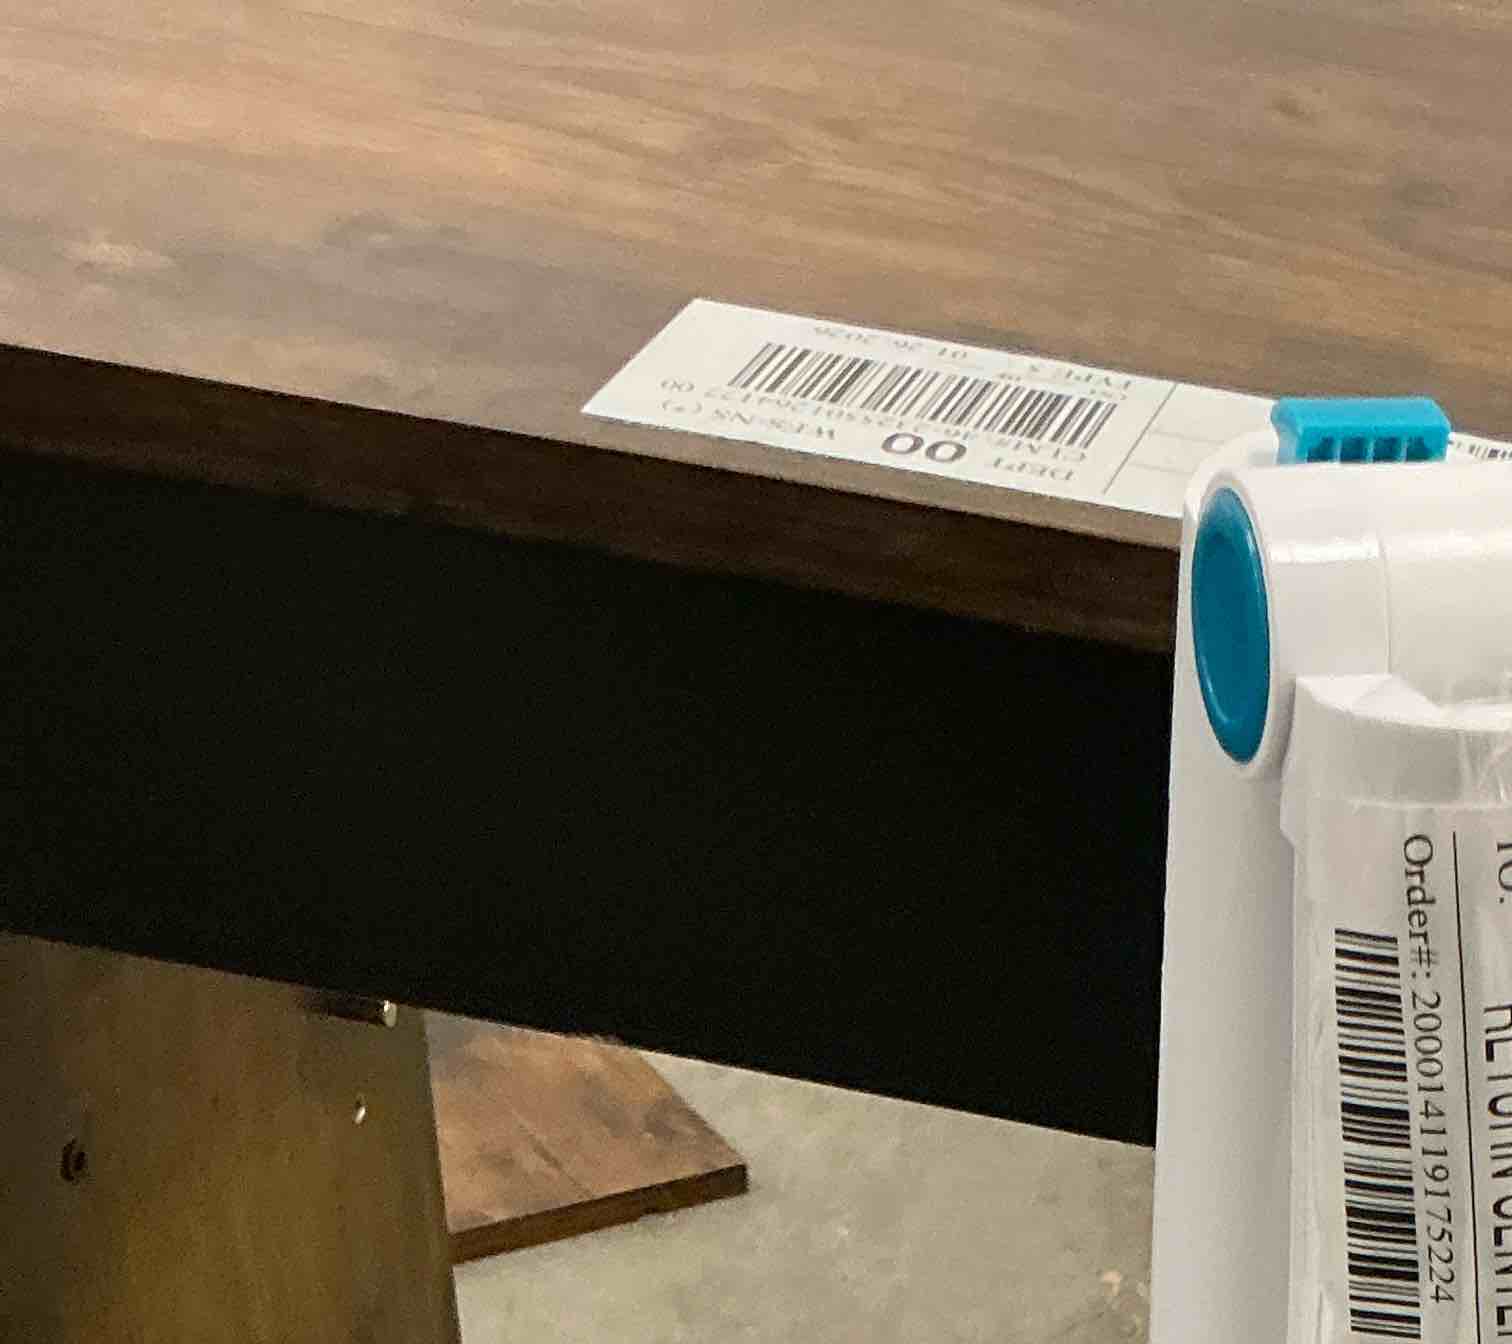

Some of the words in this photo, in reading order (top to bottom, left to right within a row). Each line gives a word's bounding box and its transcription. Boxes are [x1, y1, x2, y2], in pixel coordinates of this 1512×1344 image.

[881, 432, 967, 463] 00
[1403, 833, 1437, 979] Order#:
[1411, 991, 1456, 1305] 200014119175224
